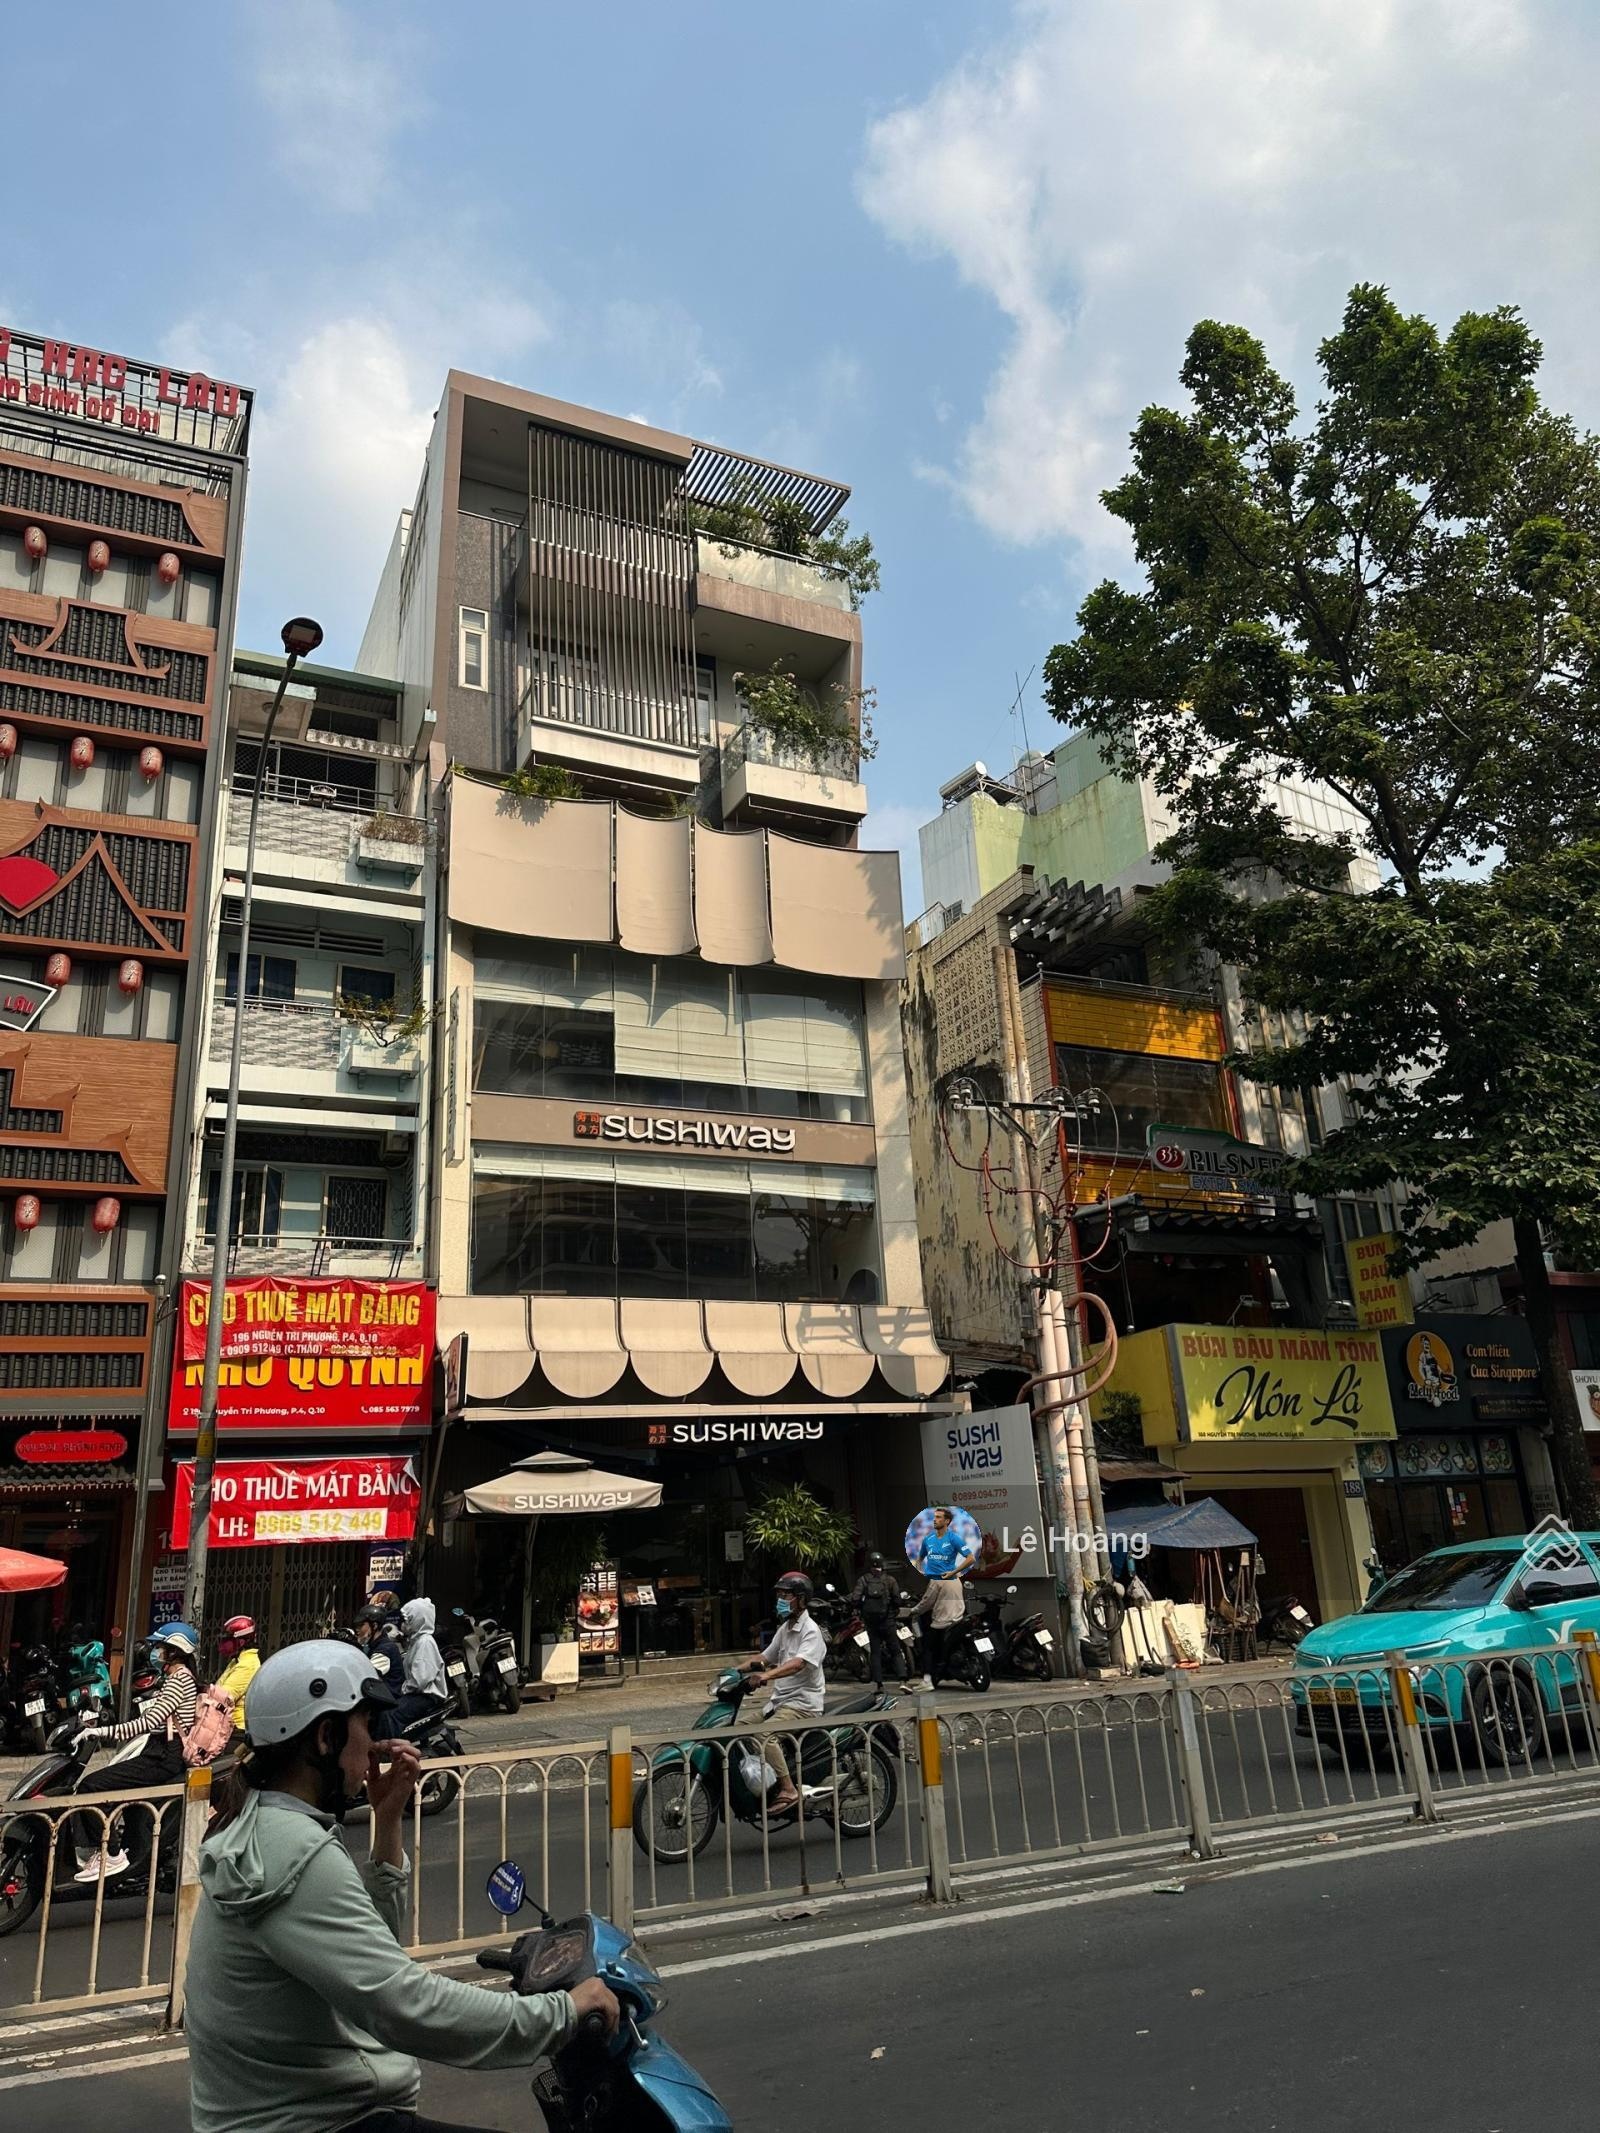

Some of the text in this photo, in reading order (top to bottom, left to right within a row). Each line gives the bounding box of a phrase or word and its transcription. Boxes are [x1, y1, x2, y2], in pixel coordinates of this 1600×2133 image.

[188, 1293, 237, 1326] CO
[244, 1286, 299, 1323] THUÊ
[305, 1286, 355, 1331] MẶT
[226, 1344, 250, 1356] 0909
[1334, 1336, 1380, 1362] TÔM
[1491, 1363, 1537, 1382] Singapore
[243, 1470, 300, 1501] THUÊ
[306, 1467, 353, 1504] MẶT
[1344, 1481, 1361, 1494] 188
[218, 1516, 249, 1538] LH:
[309, 1512, 343, 1533] 512
[347, 1510, 383, 1531] 449
